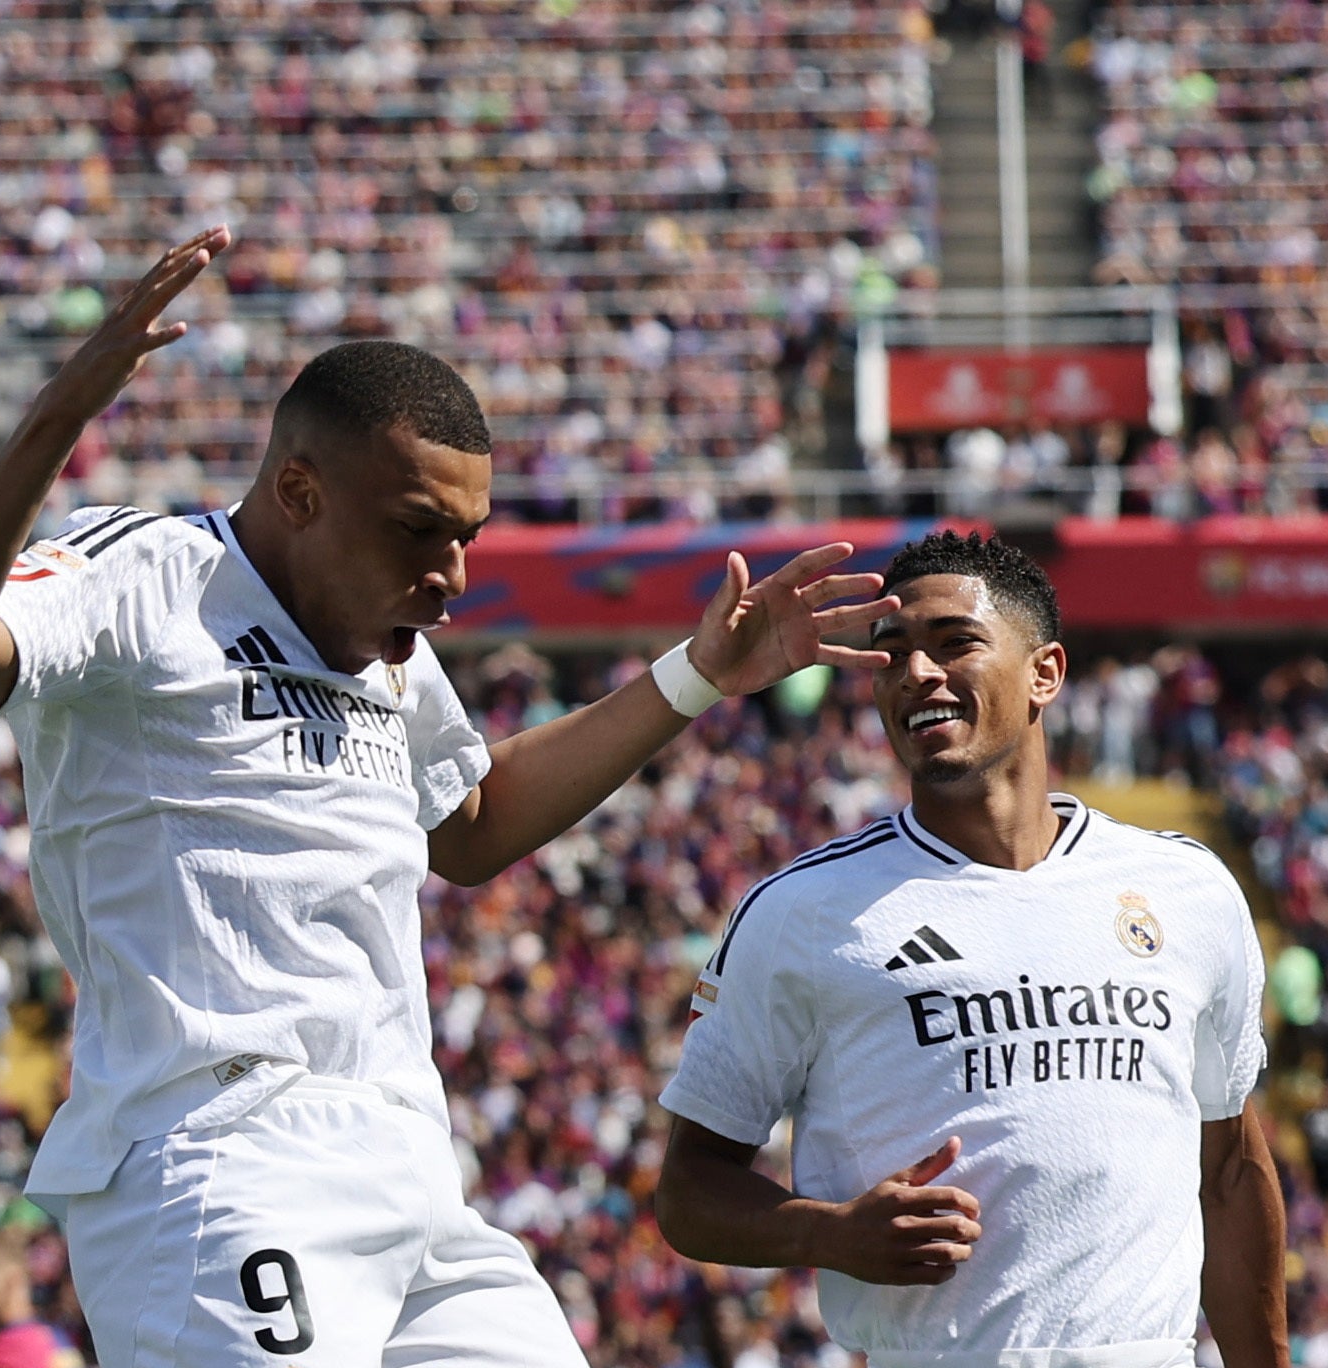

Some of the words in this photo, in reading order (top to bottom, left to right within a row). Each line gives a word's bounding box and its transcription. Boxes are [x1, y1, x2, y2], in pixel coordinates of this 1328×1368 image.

[283, 729, 328, 774] FLY
[903, 974, 1171, 1047] Emirates
[965, 1043, 1018, 1093] FLY
[1034, 1038, 1145, 1083] BETTER
[239, 1248, 315, 1355] 9
